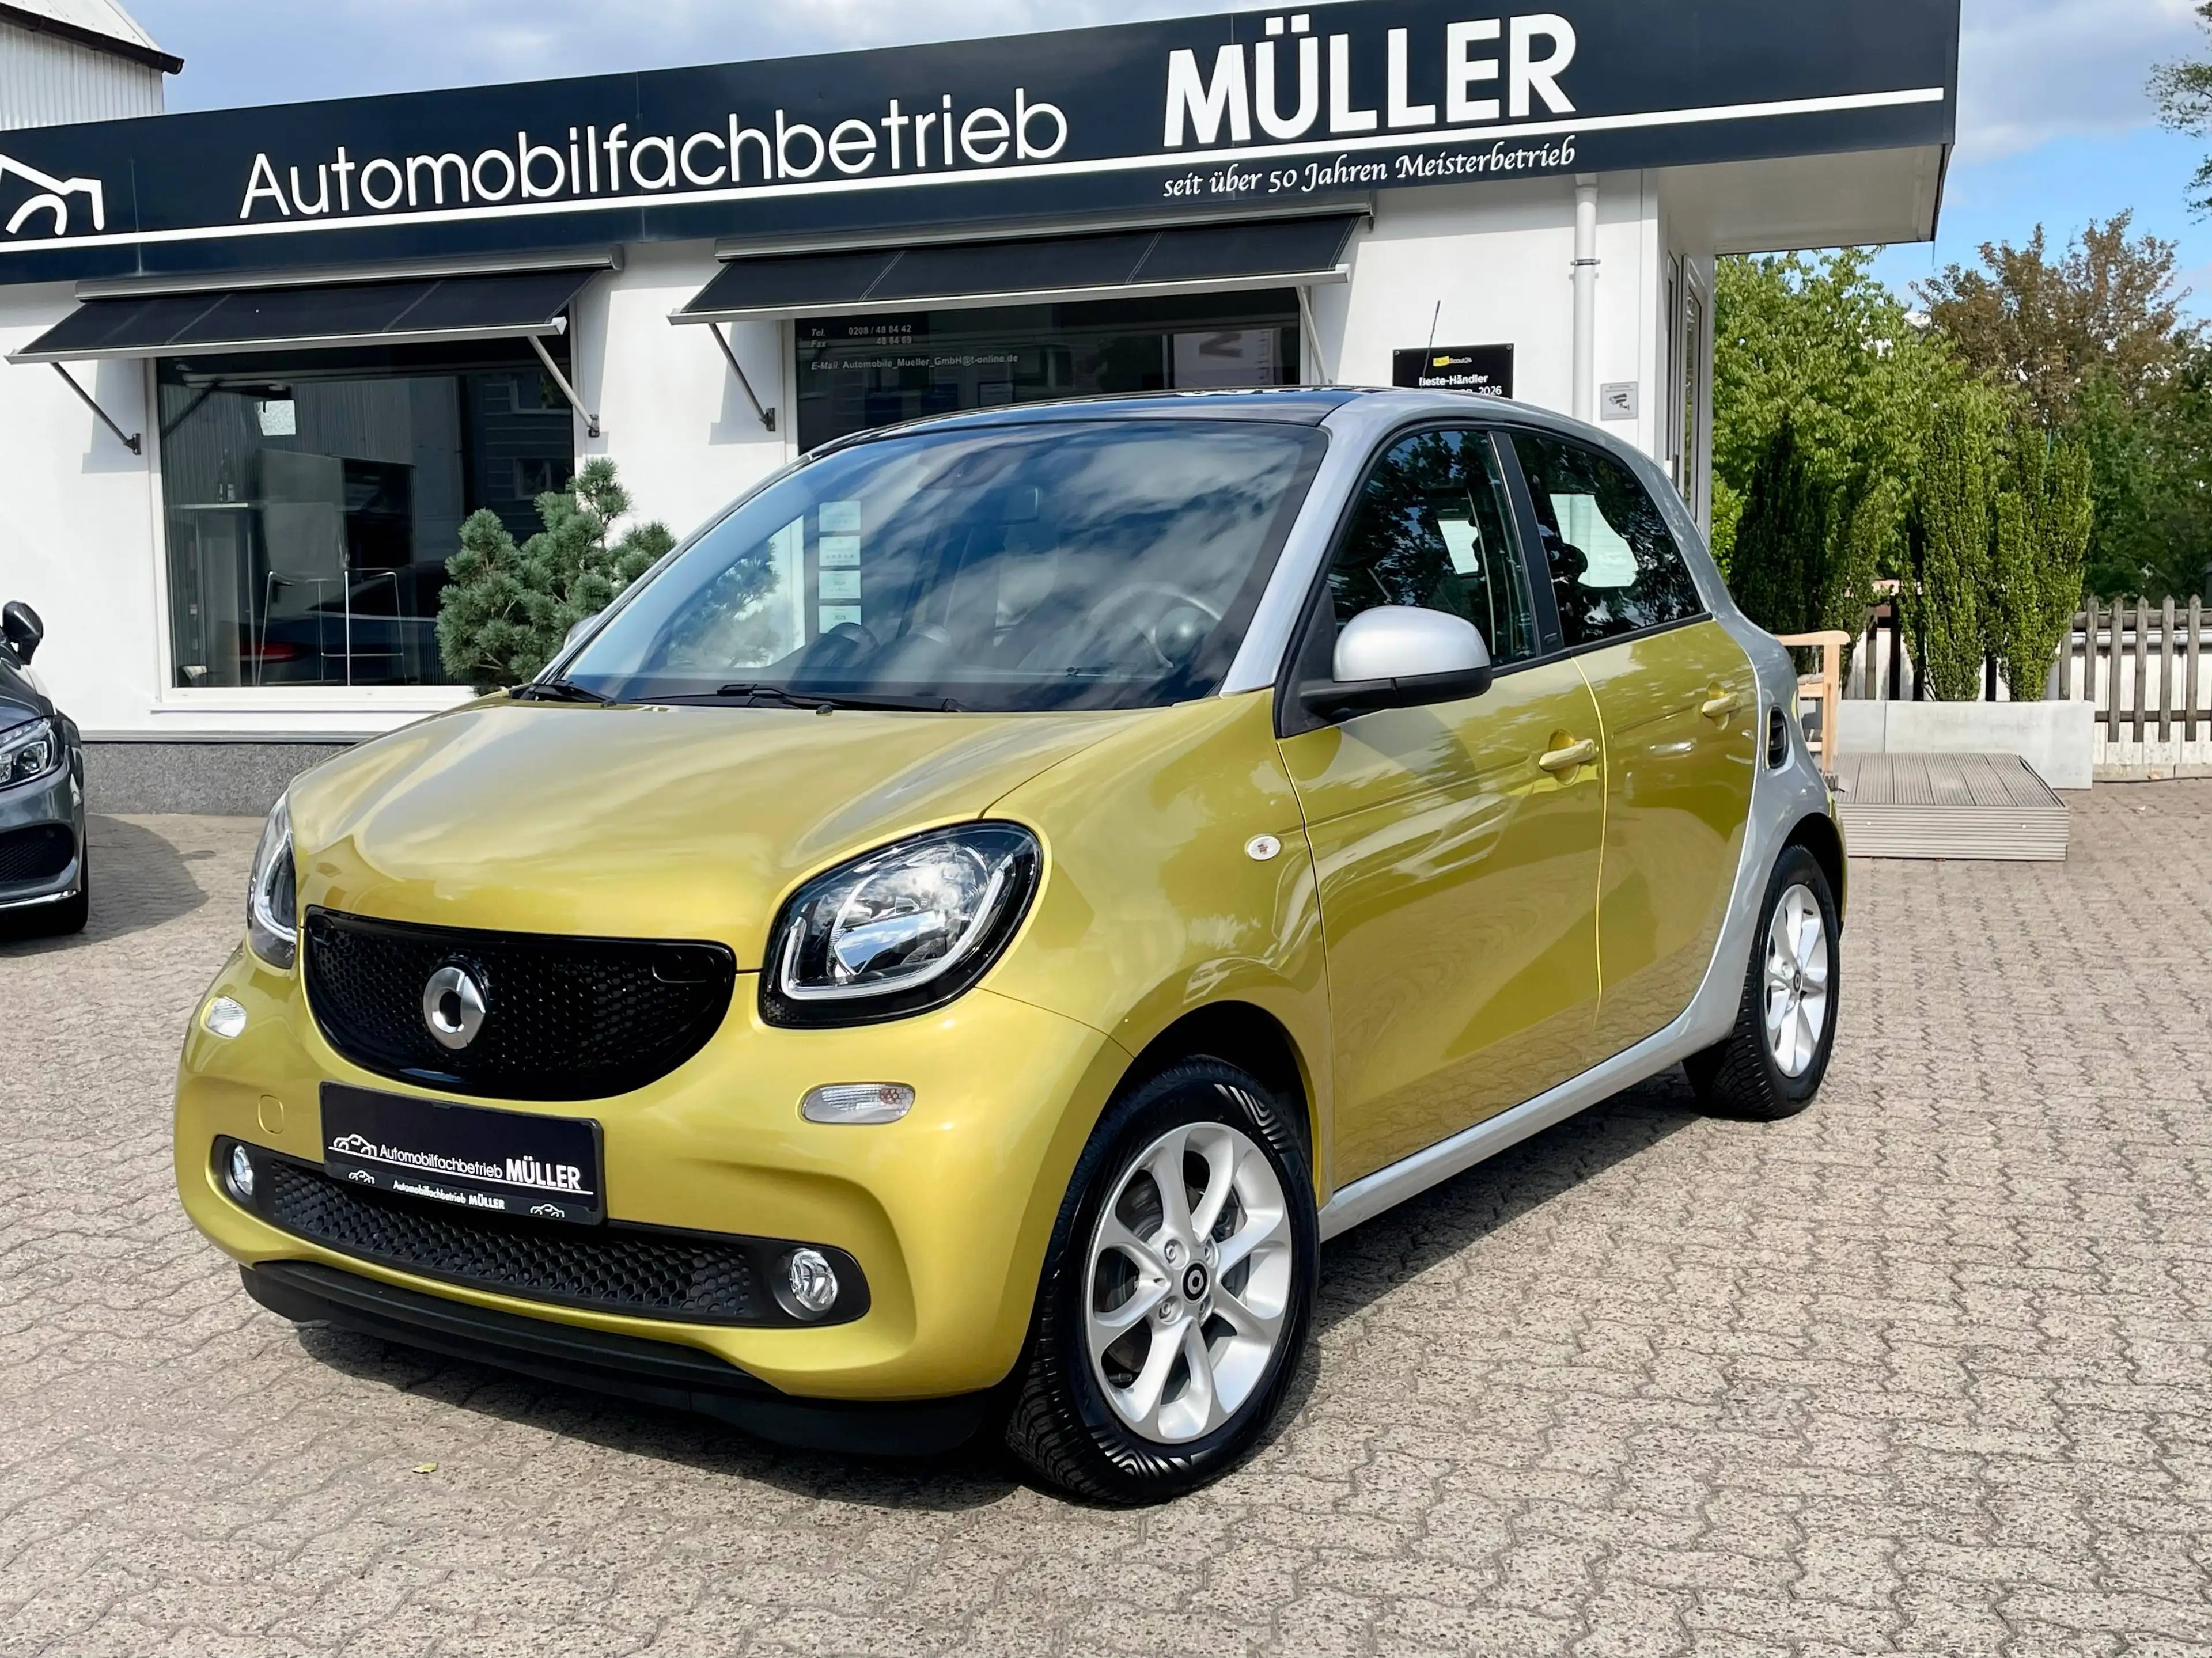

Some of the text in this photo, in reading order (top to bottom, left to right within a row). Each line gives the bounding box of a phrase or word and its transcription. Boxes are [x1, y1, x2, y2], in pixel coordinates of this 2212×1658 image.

[240, 14, 1577, 219] Automobilfachbetrieb MÜLLER
[1163, 135, 1575, 196] seit über 50 Jahren Meisterbetrieb
[811, 328, 825, 337] Tel.
[848, 327, 868, 335] 0208
[876, 325, 886, 334] 48
[888, 325, 899, 333] 84
[901, 324, 911, 333] 42
[811, 340, 827, 348] Fax
[888, 336, 899, 344] 84
[1478, 385, 1502, 396] 2026
[380, 1144, 582, 1190] Automobilfachbetrieb MÜLLER
[468, 1193, 506, 1210] MÜLLER
